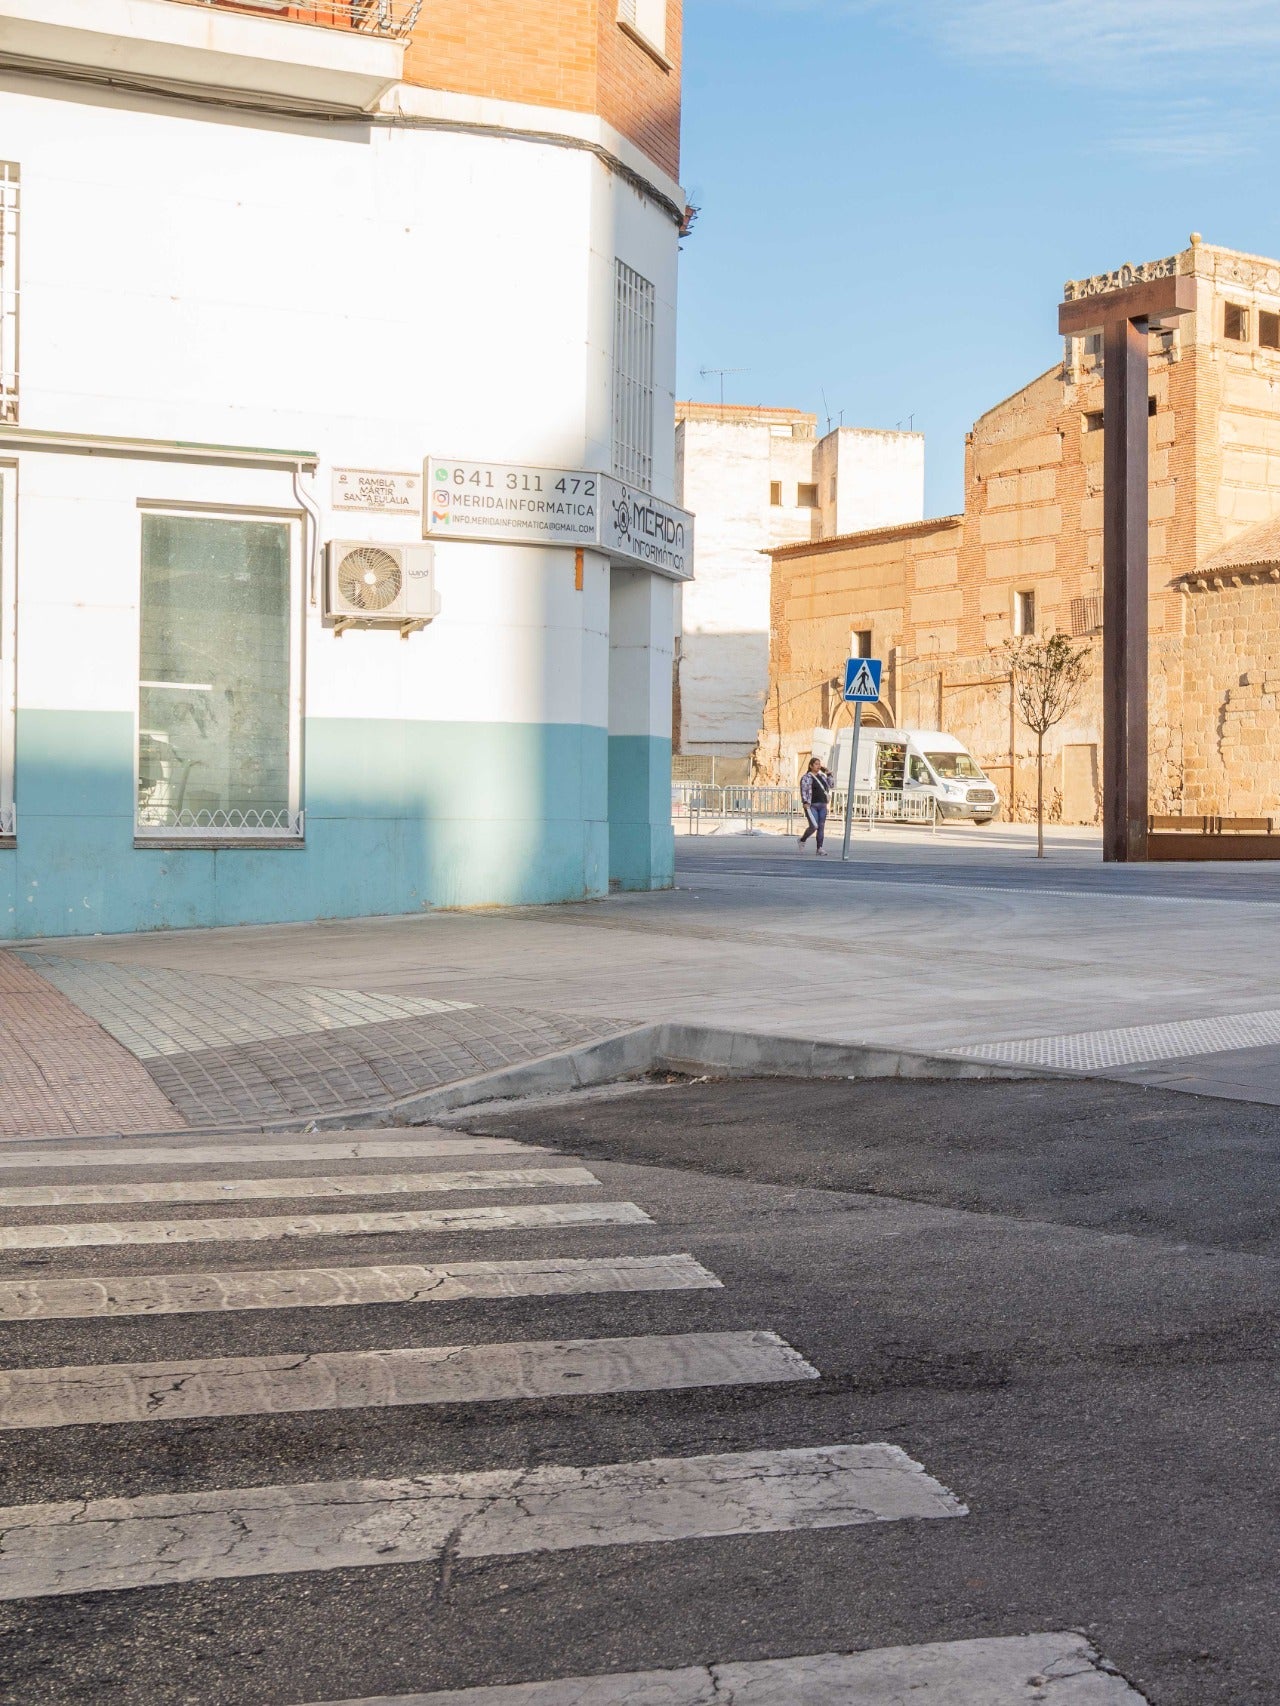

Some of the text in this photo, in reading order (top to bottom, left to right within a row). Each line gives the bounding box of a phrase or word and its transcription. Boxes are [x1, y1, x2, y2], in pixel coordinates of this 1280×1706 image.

[358, 477, 396, 488] RAMBLA
[453, 468, 596, 497] 641 311 472
[343, 492, 373, 503] SANTA
[374, 495, 409, 505] EULALIA
[452, 493, 595, 517] MERIDAINFORMATICA
[452, 513, 595, 534] INFO.MERIDAINFORMATICA@GMAIL.COM
[633, 498, 685, 549] MÉRIDA
[632, 537, 685, 571] INFORMÁTICA
